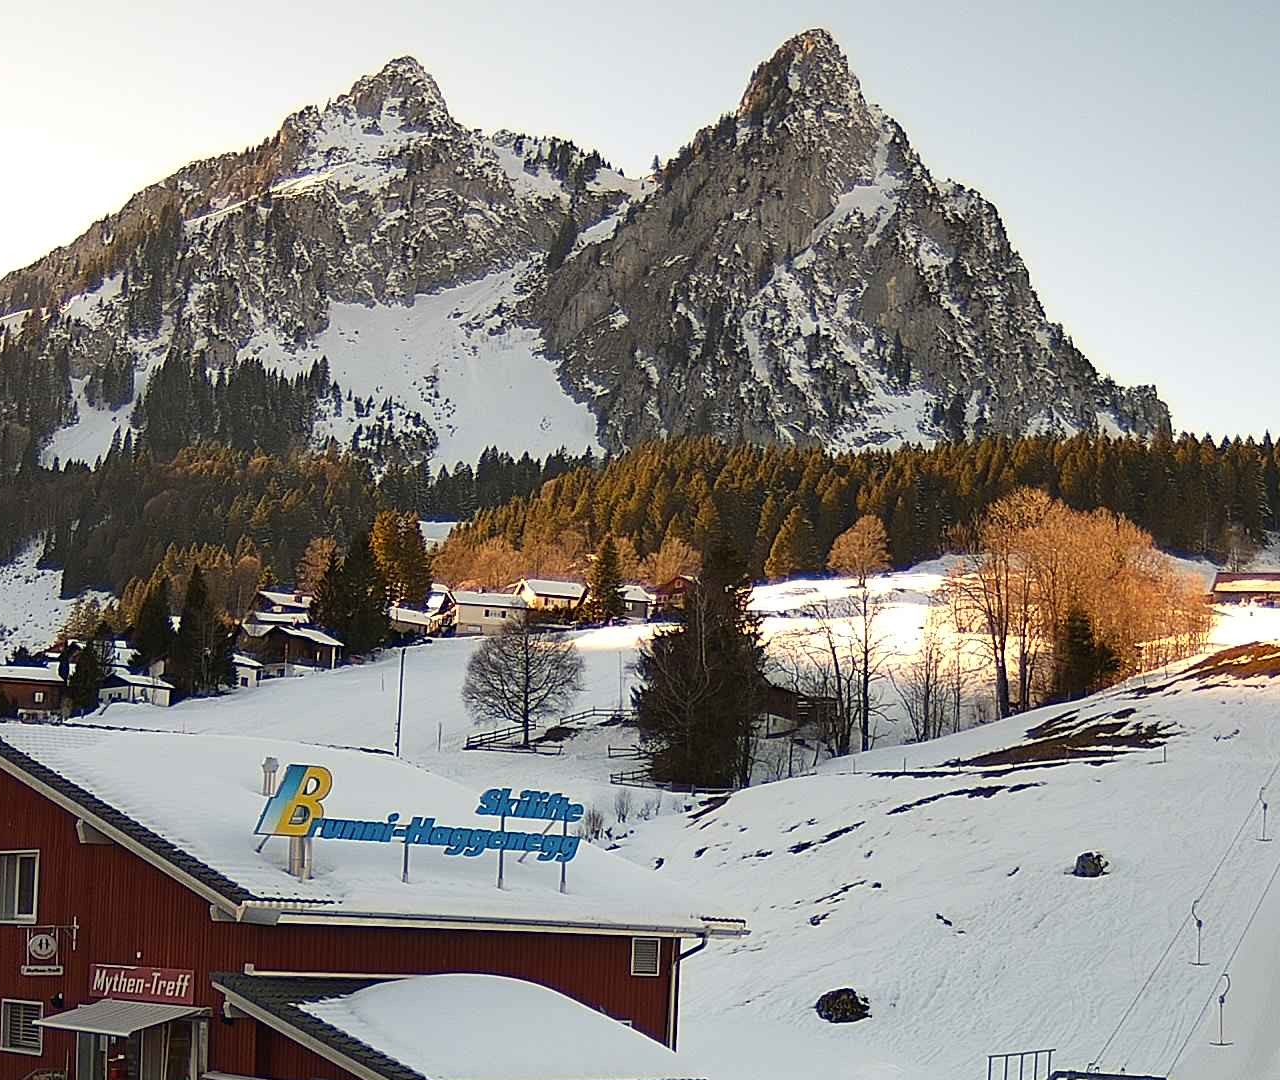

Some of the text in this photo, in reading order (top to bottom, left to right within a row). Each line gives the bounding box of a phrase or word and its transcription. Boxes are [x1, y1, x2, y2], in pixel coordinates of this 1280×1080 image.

[254, 764, 581, 862] Brunni-Haggenegg
[476, 787, 585, 822] Skilifte
[92, 968, 191, 998] Mythen-Treff
